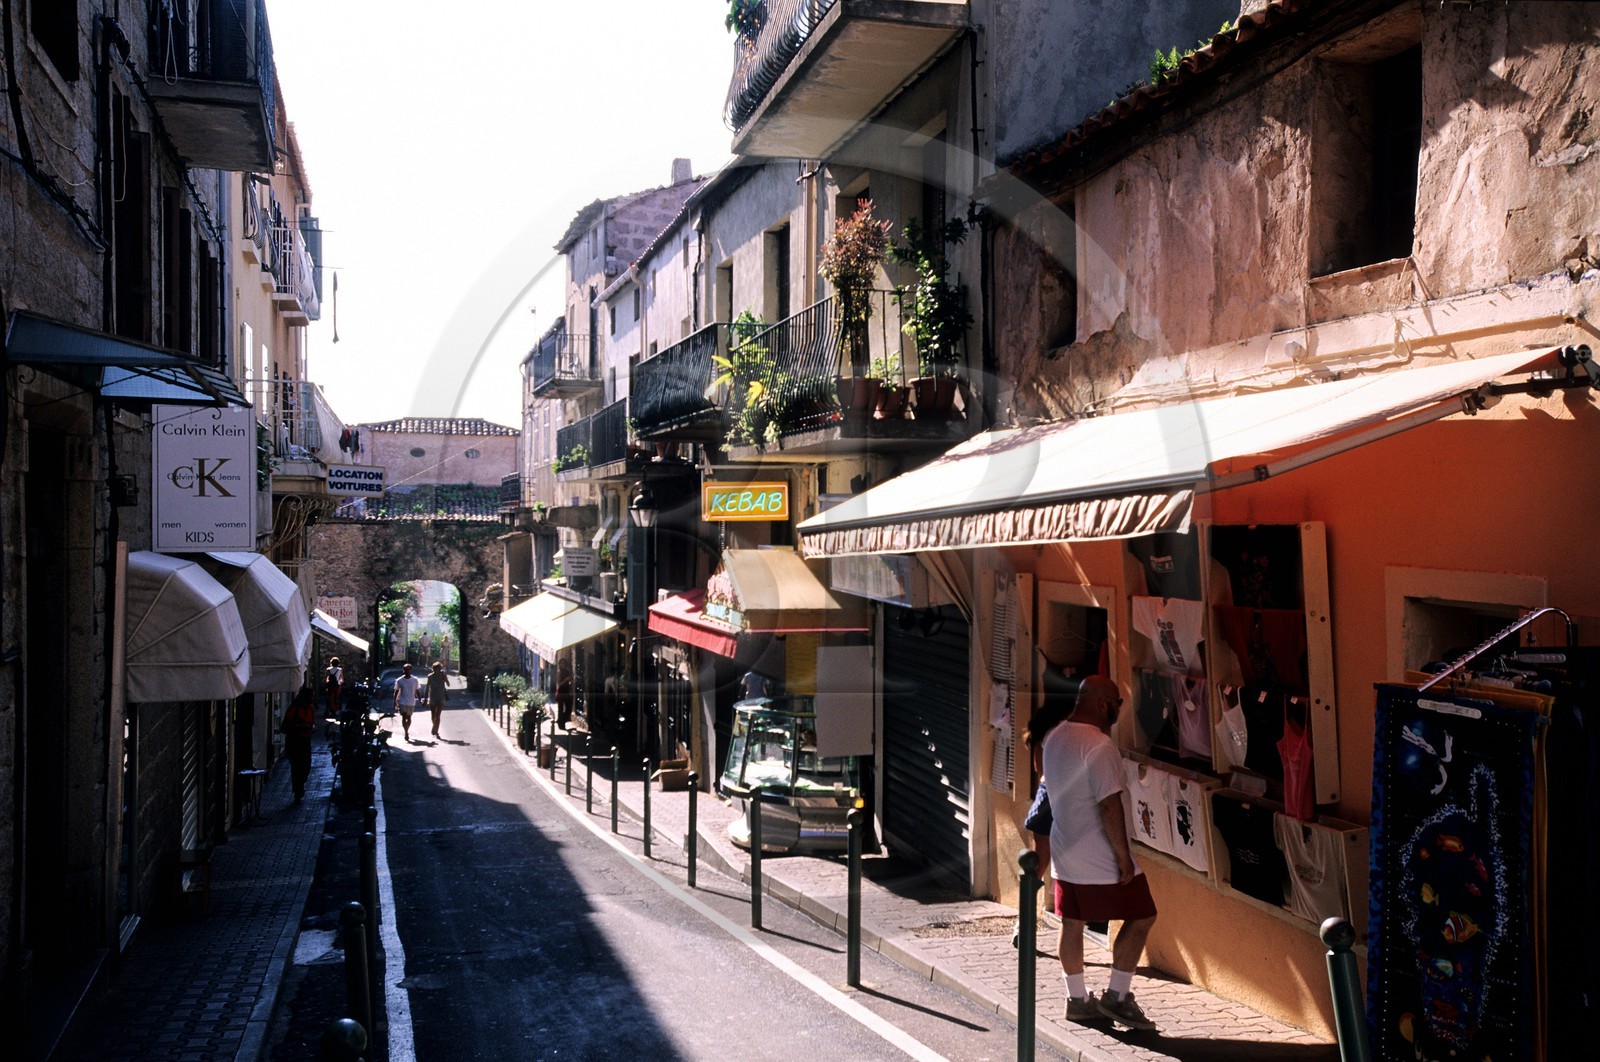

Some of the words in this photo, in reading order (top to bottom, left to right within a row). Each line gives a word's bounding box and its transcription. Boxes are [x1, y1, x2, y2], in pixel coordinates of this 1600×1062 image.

[162, 422, 207, 436] Calvin
[212, 424, 246, 437] Klein
[218, 473, 241, 481] Jeans
[328, 469, 383, 480] LOCATION
[328, 480, 383, 492] VOITURES
[710, 491, 783, 513] KEBAB
[185, 531, 215, 543] KIDS
